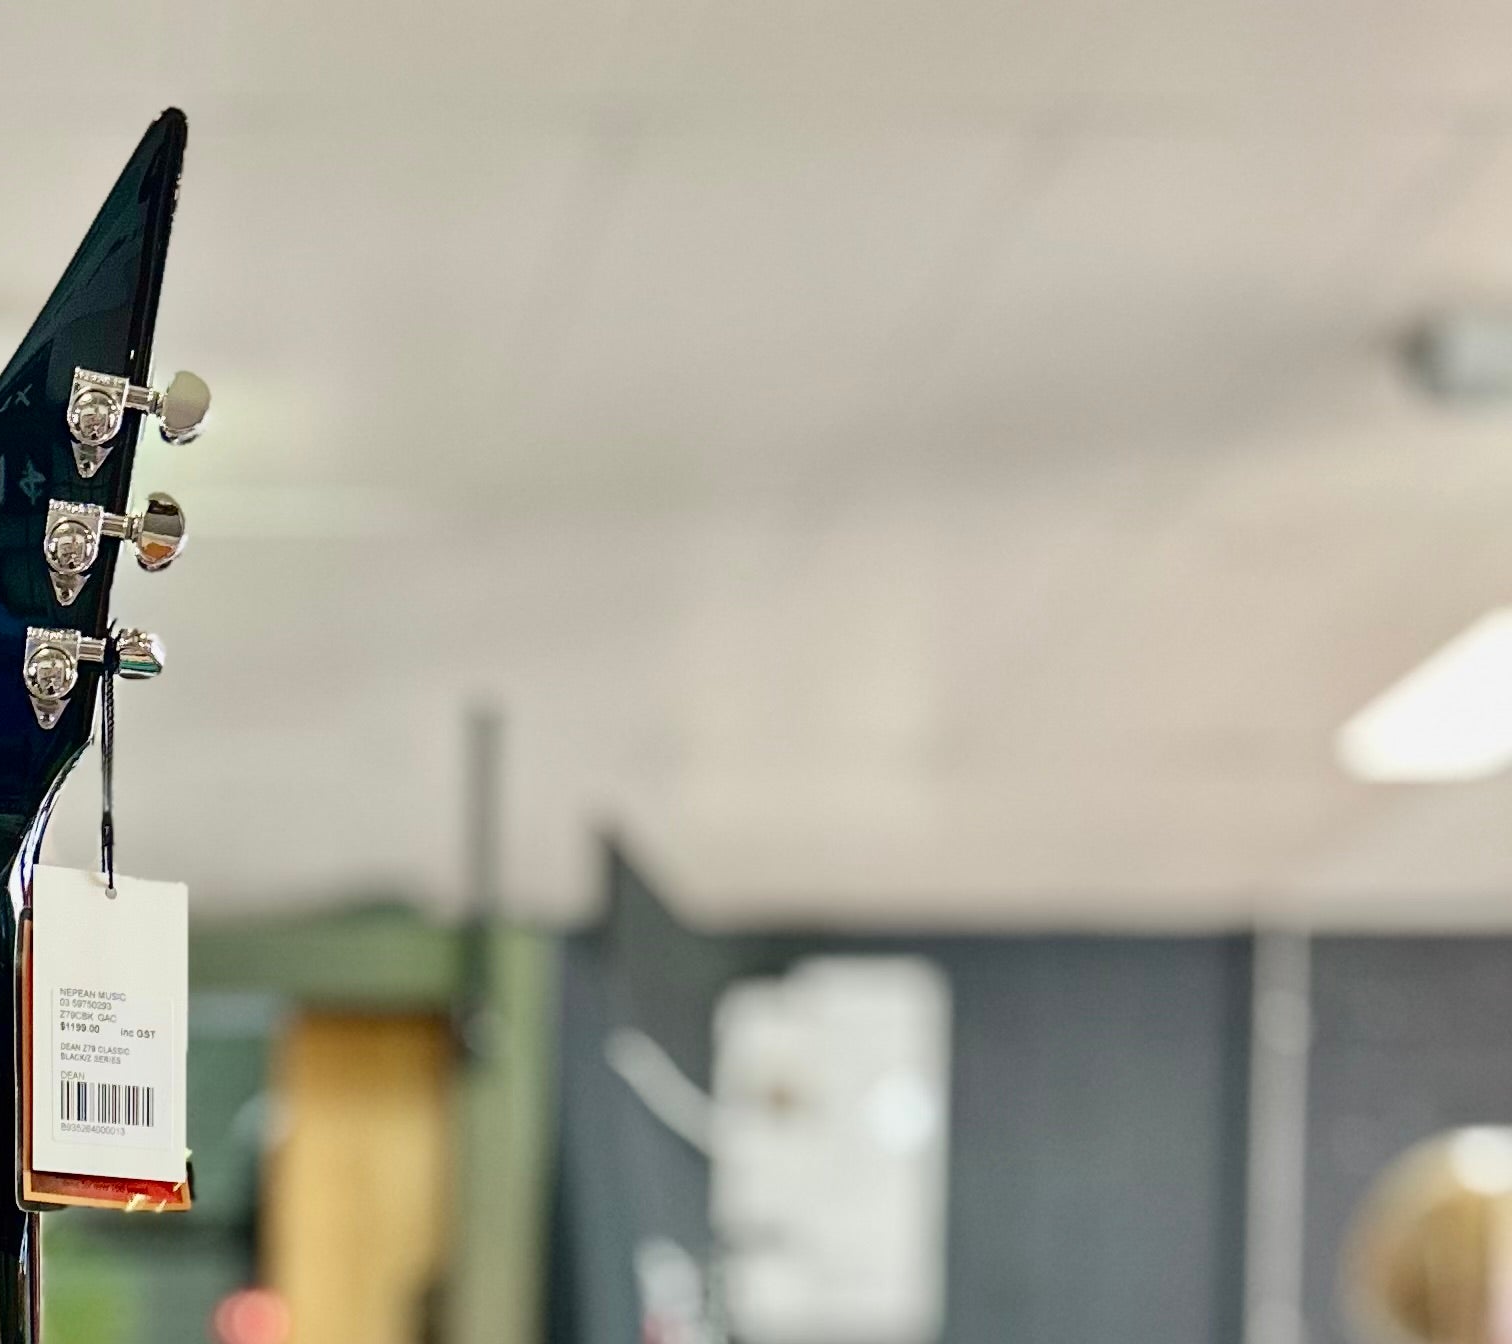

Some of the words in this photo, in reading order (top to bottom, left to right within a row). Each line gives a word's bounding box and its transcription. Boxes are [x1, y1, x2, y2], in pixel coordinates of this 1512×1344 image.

[59, 988, 96, 999] NEPEAN
[98, 991, 127, 1002] MUSIC
[60, 1022, 100, 1033] $1199.00
[120, 1028, 134, 1038] inc
[60, 1042, 81, 1052] DEAN
[97, 1045, 130, 1056] CLASSIC
[94, 1054, 121, 1065] SERIES
[60, 1070, 85, 1080] DEAN
